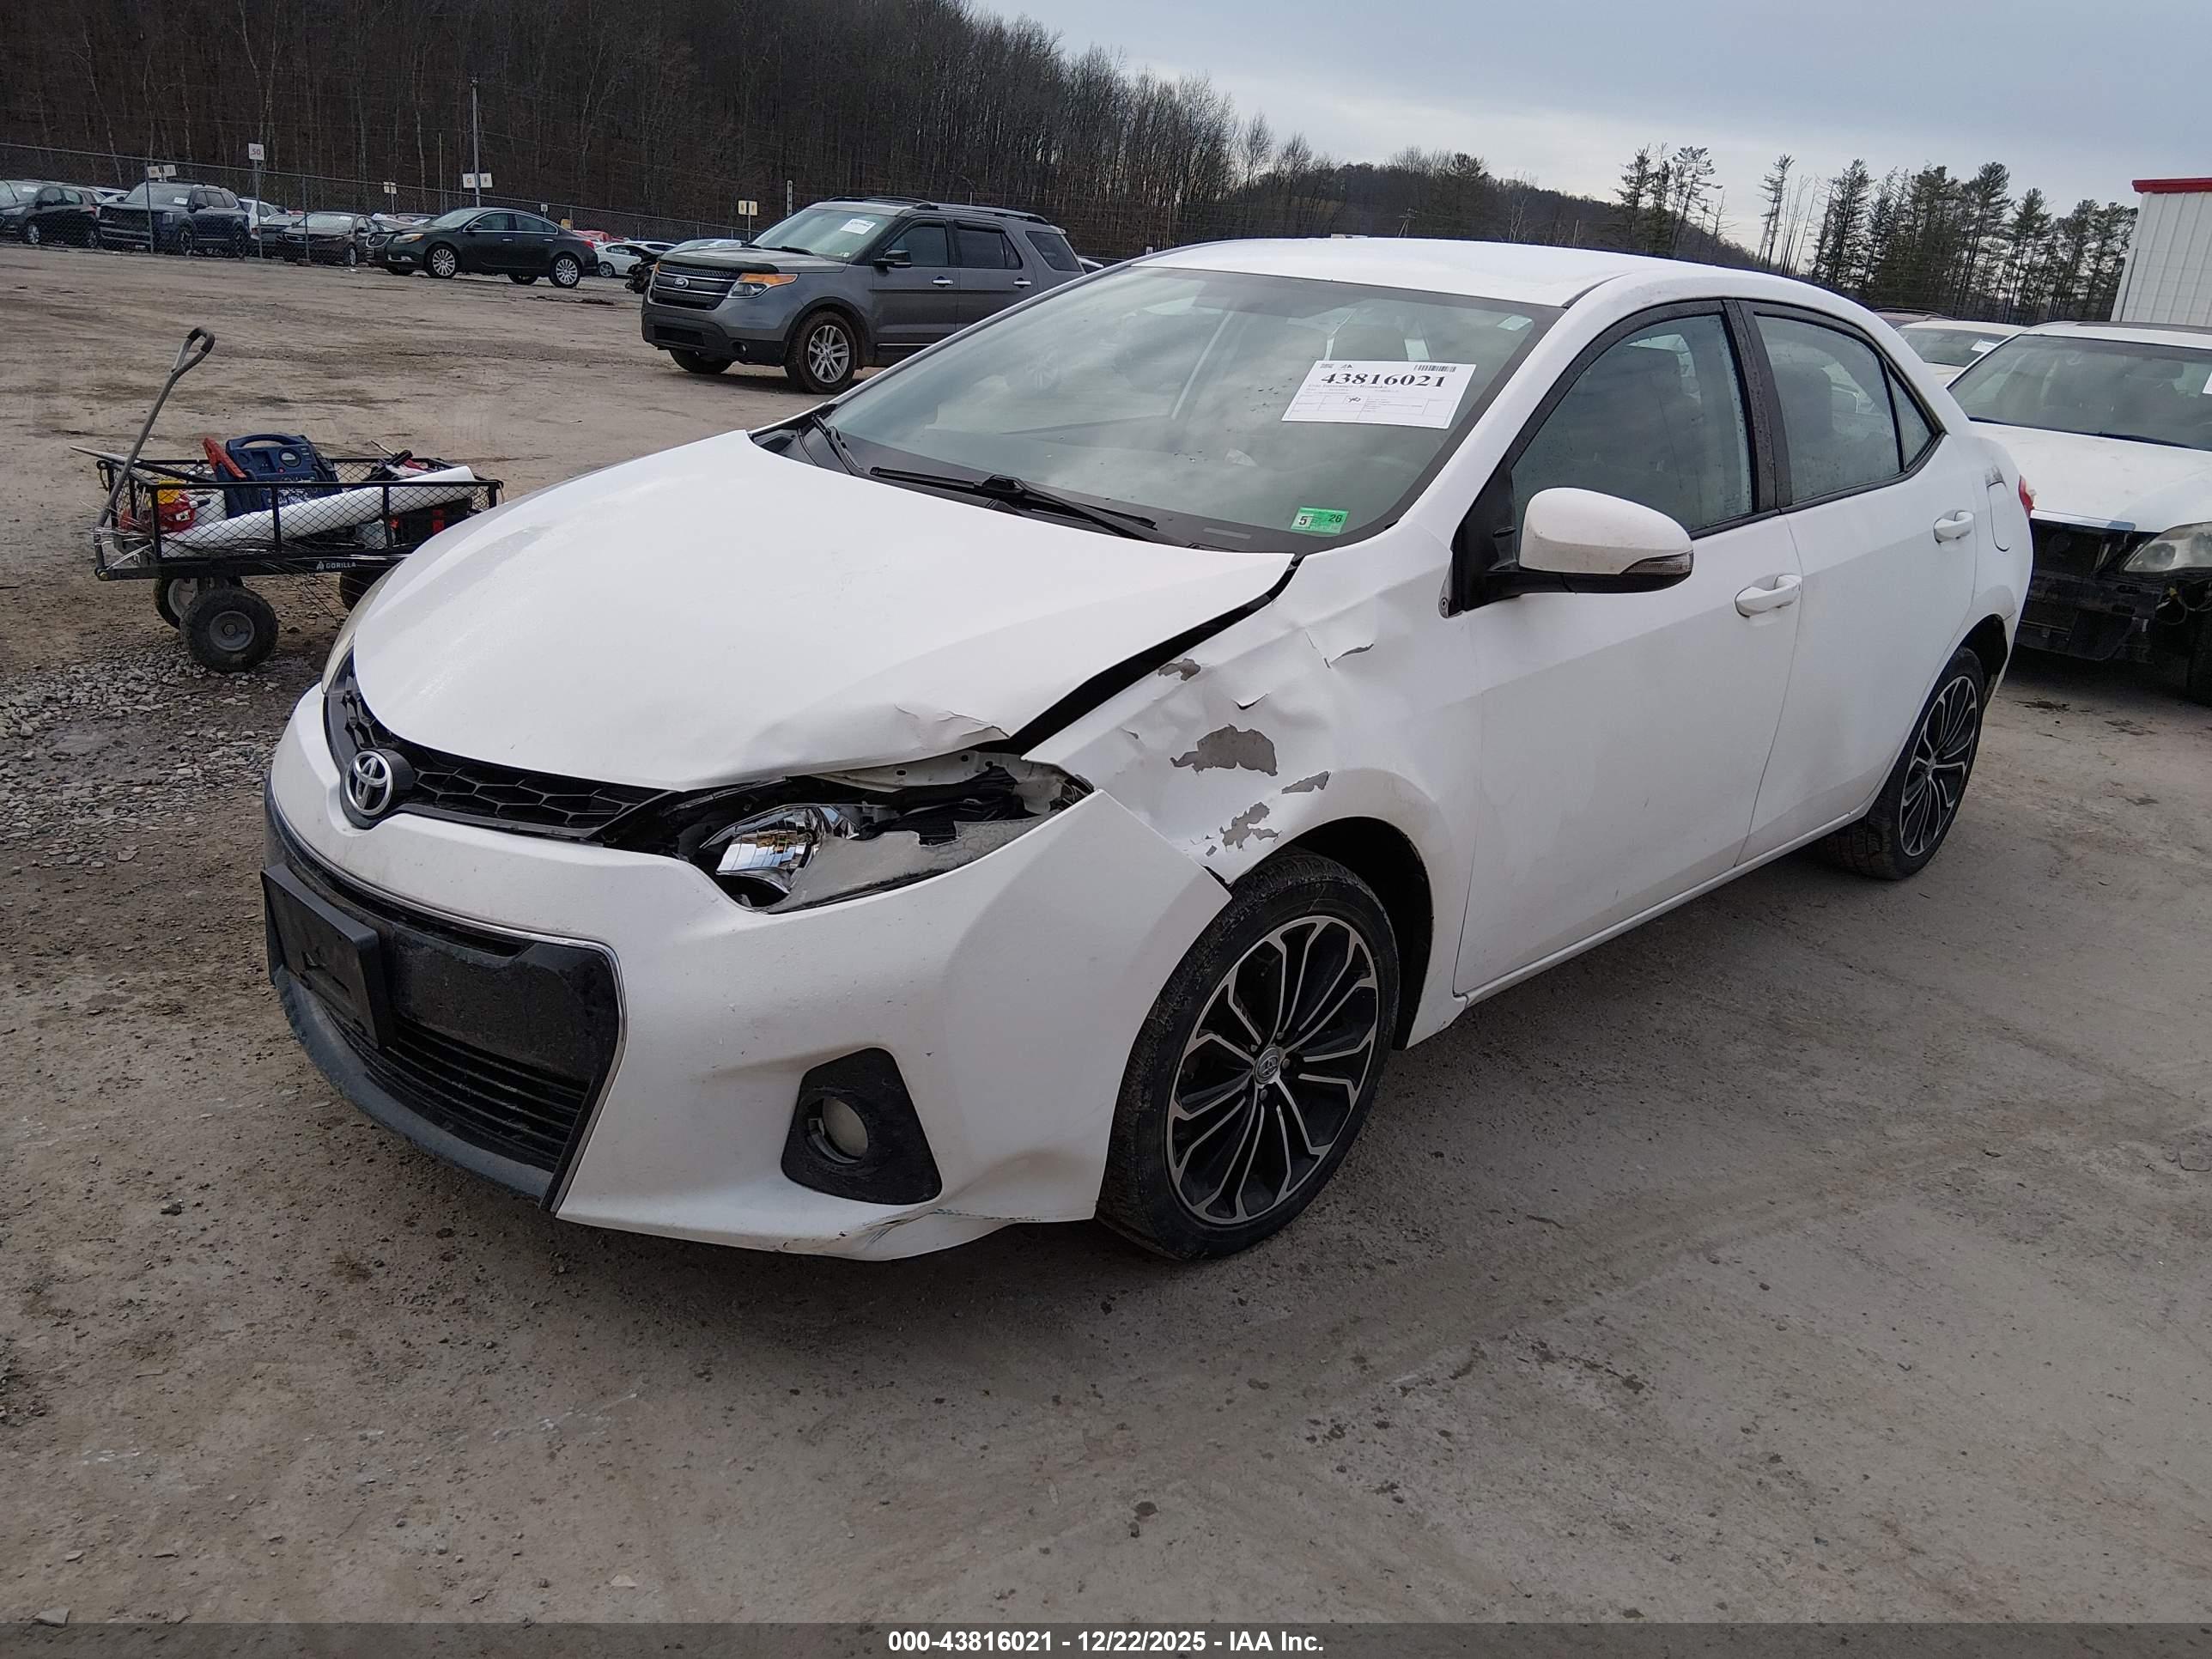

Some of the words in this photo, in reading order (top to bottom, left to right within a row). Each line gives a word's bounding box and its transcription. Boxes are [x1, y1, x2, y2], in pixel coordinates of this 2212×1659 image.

[1321, 373, 1446, 387] 43816021
[1298, 515, 1309, 526] 5
[1328, 514, 1343, 523] 26
